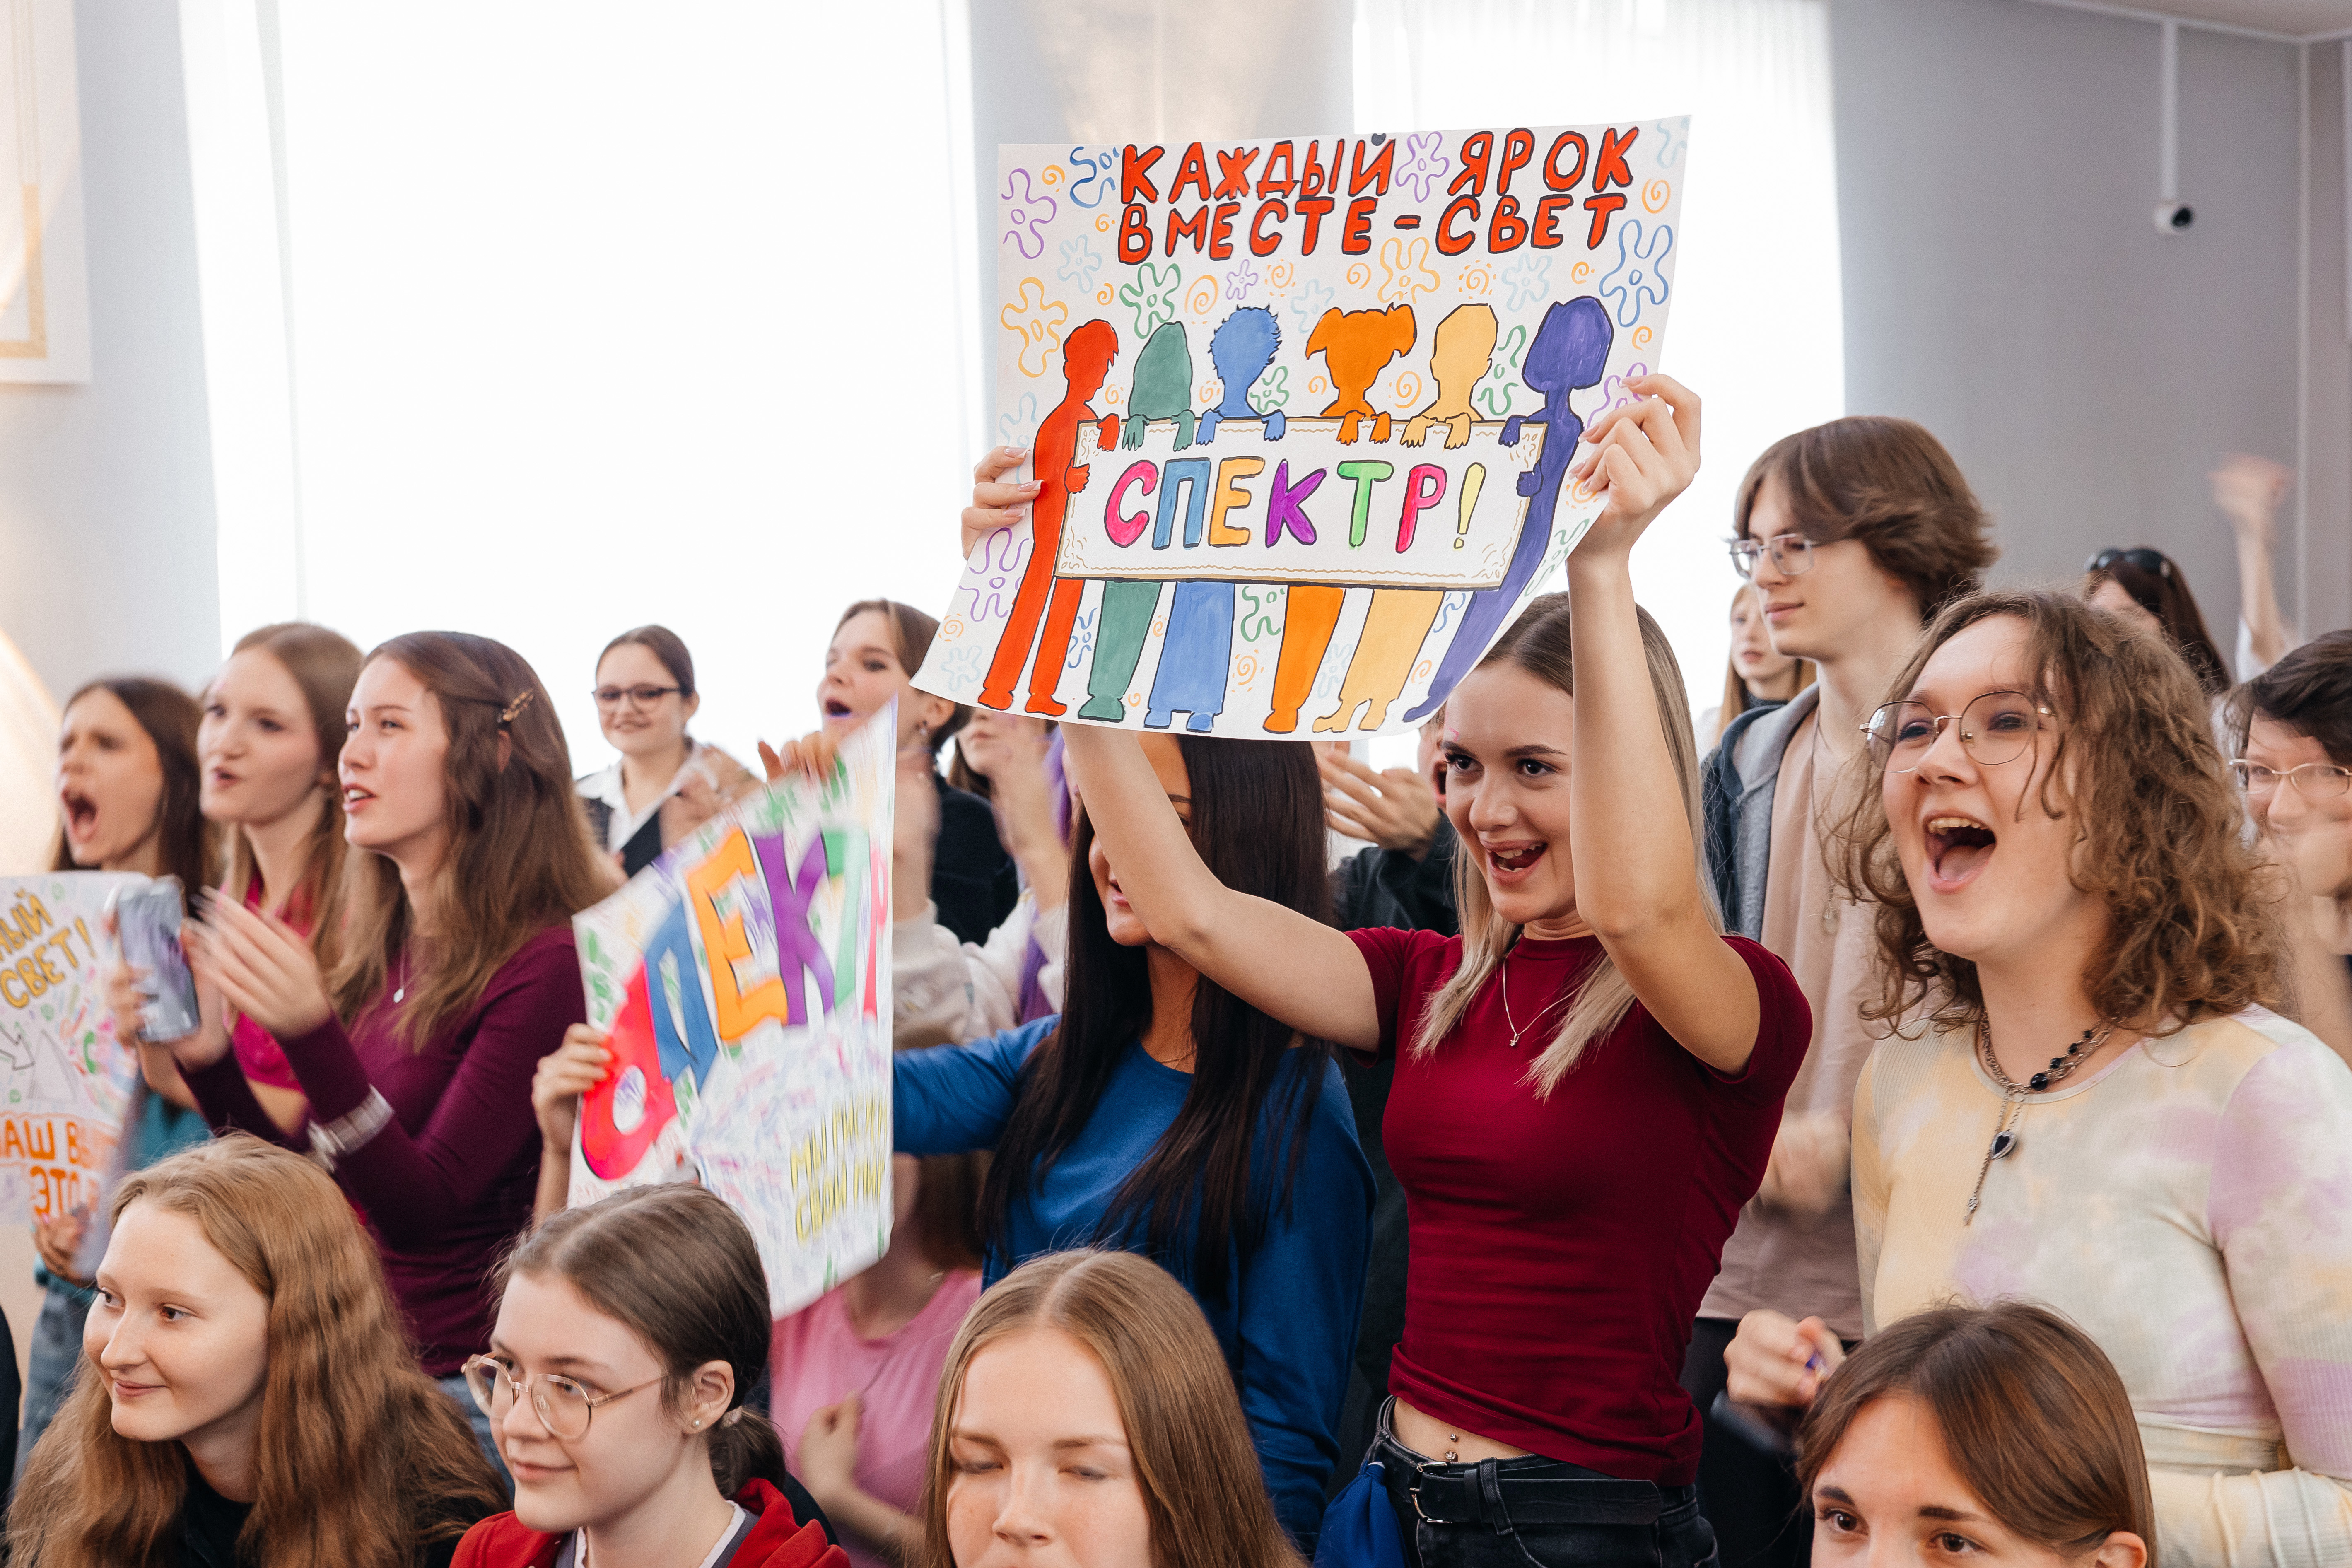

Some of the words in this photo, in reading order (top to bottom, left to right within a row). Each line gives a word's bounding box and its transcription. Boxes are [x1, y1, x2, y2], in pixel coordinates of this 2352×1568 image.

[1121, 133, 1395, 204] КАЖДЫЙ
[1447, 126, 1640, 196] ЯРОК
[1118, 196, 1379, 265] ВМЕСТЕ
[1435, 193, 1628, 256] СВЕТ
[1104, 456, 1487, 553] СПЕКТР!
[0, 915, 99, 1009] СВЕТ!
